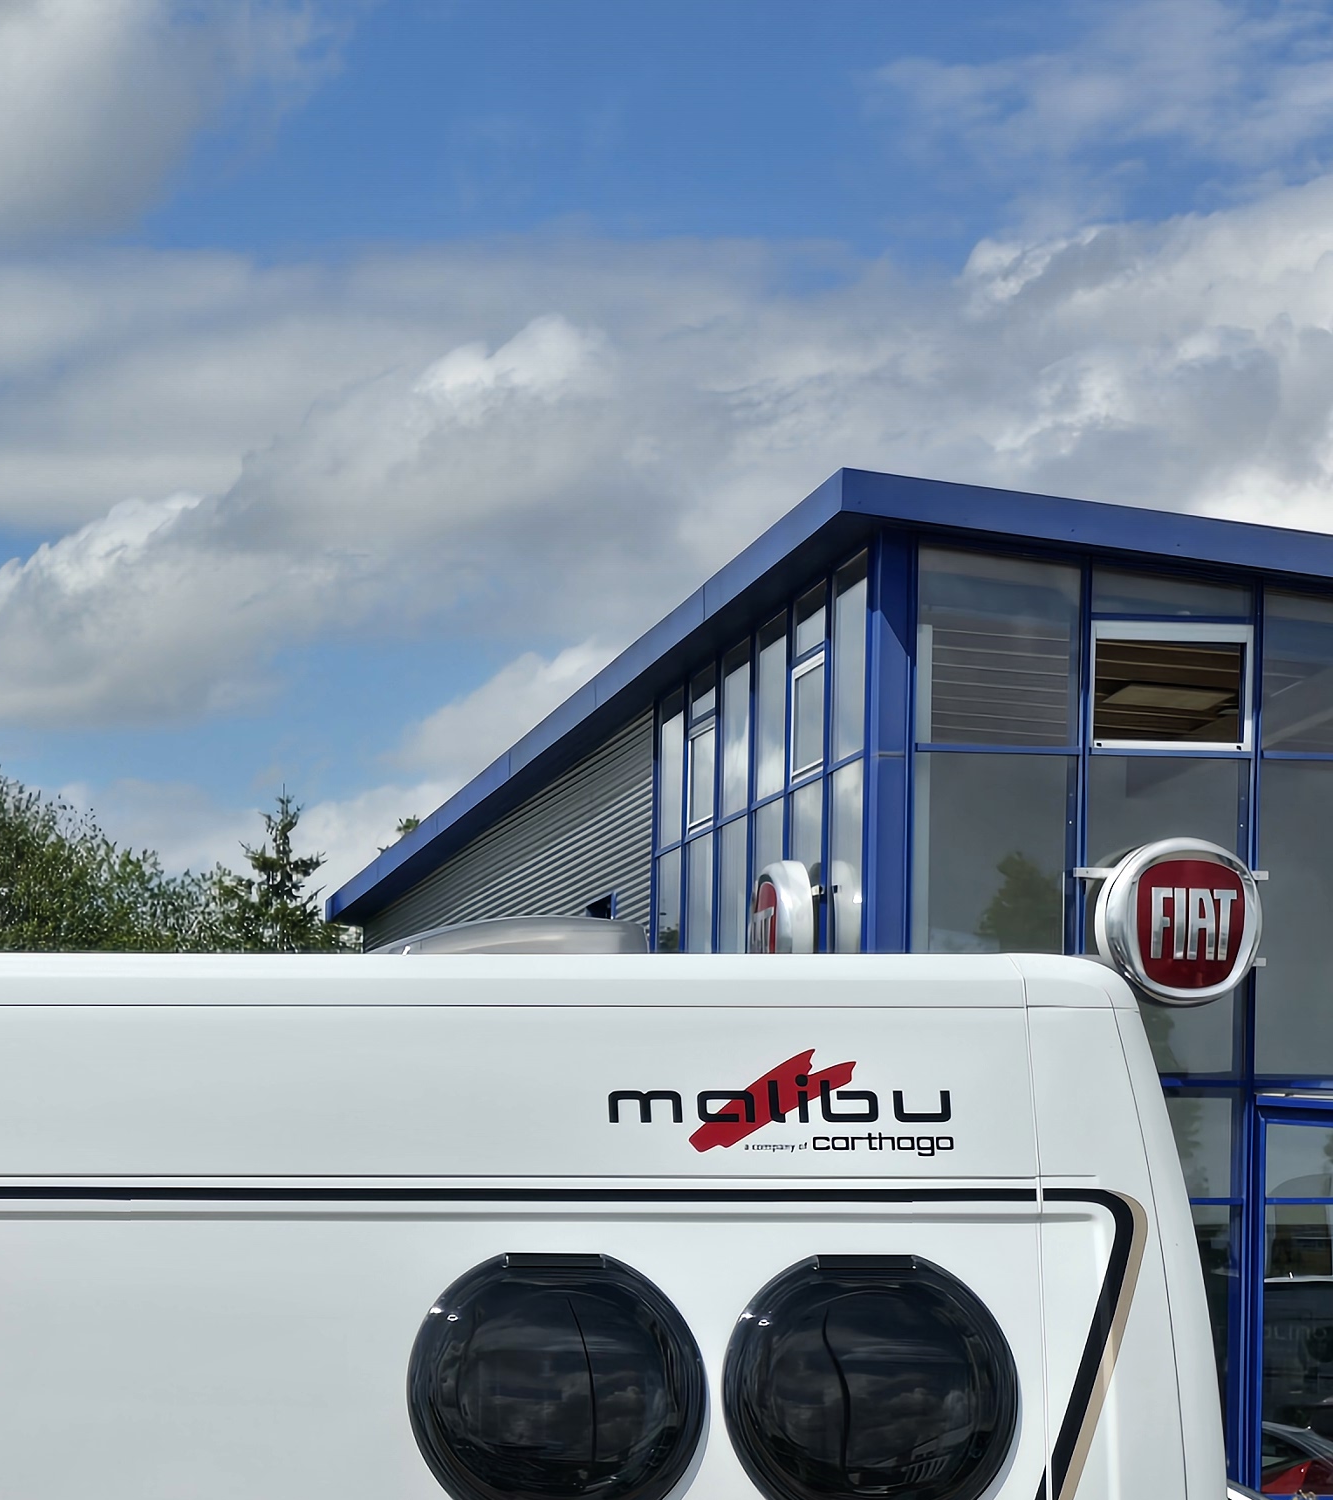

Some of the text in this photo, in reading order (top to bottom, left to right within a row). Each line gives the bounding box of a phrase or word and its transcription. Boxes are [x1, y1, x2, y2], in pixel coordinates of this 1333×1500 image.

[1150, 886, 1238, 961] FIAT
[608, 1073, 951, 1124] malibu
[812, 1132, 955, 1157] carthago
